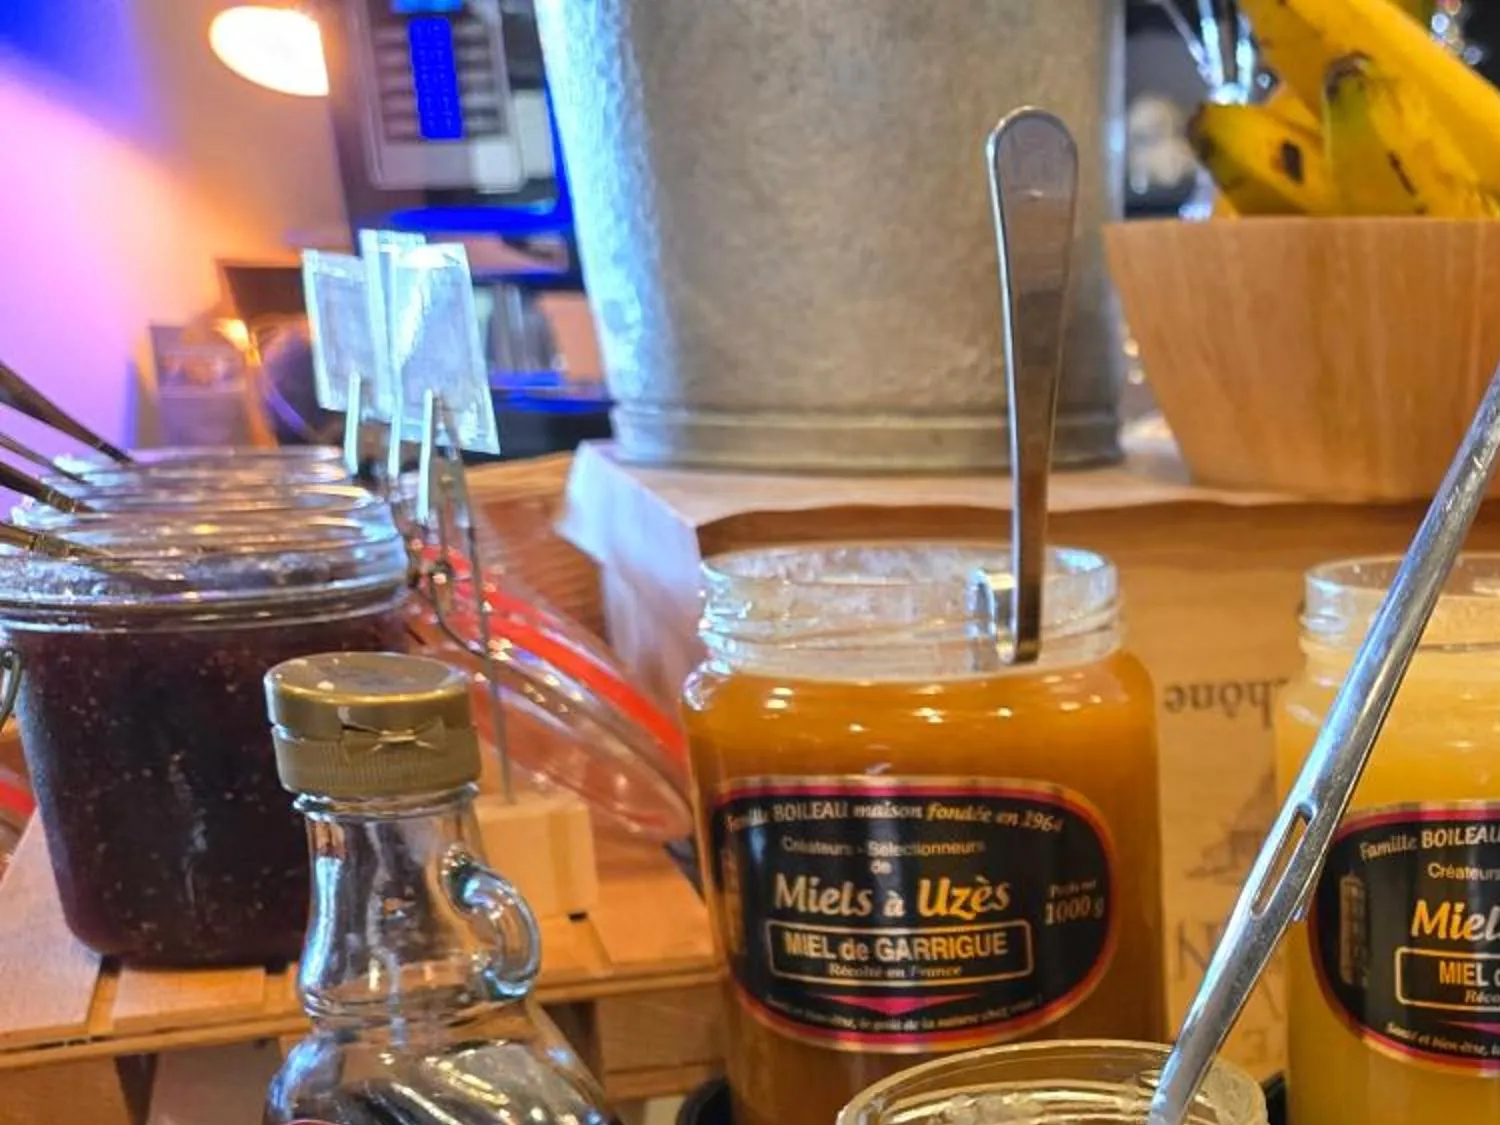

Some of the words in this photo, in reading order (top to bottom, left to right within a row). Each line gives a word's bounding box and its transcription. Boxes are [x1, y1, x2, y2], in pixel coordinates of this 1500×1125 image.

[1163, 677, 1289, 733] hône
[773, 800, 848, 821] BOILEAU
[853, 800, 922, 819] maison
[926, 801, 993, 823] fondée
[996, 811, 1019, 825] en
[775, 872, 873, 917] Miels
[882, 890, 906, 918] à
[917, 875, 1012, 920] Uzès
[783, 930, 836, 960] MIEL
[839, 937, 869, 962] de
[875, 932, 1009, 963] GARRIGUE
[1438, 959, 1489, 987] MIEL
